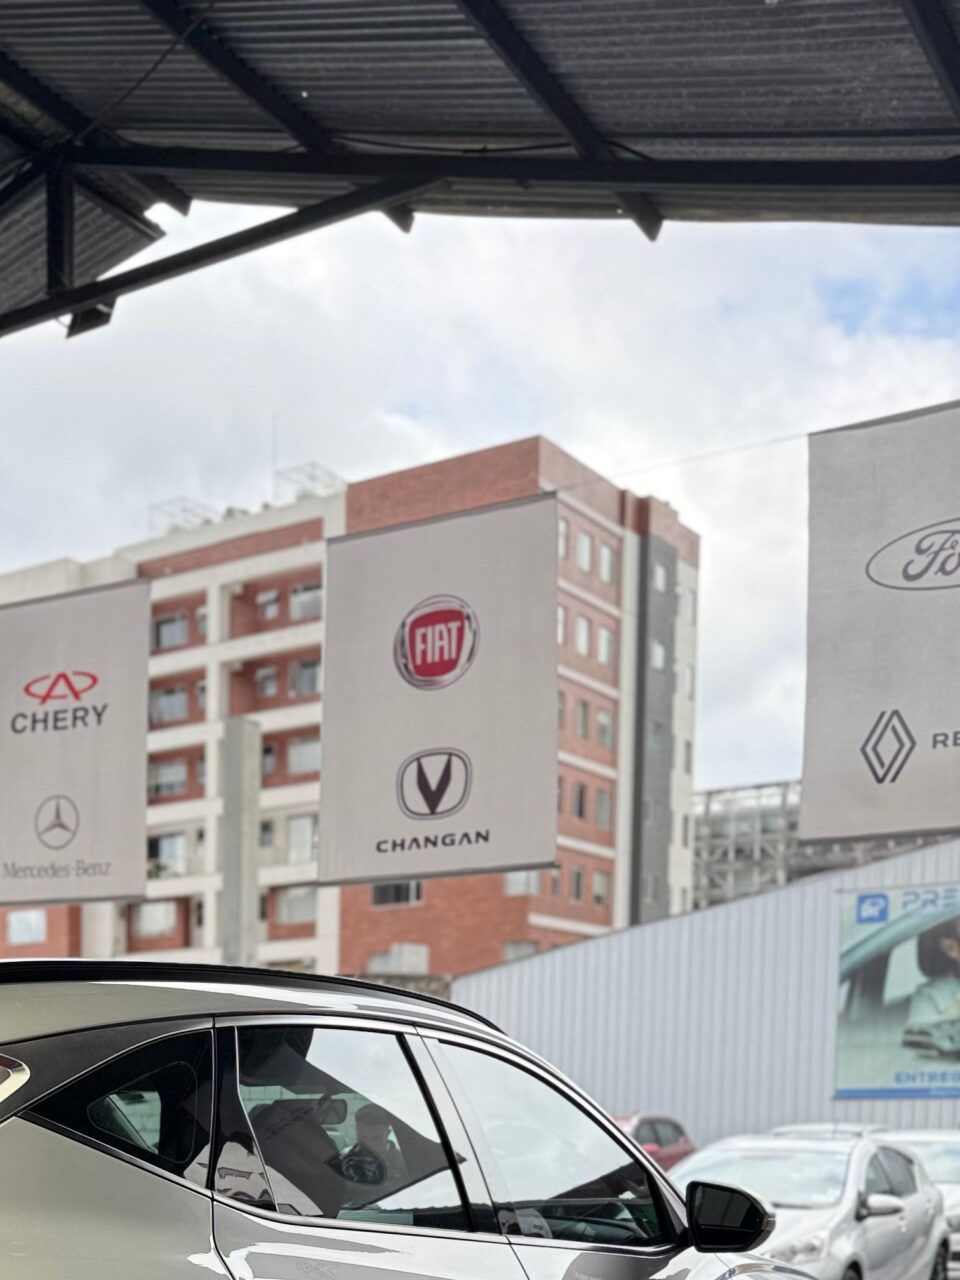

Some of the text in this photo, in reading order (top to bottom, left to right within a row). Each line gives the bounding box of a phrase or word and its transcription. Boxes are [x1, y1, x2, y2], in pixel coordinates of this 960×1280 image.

[415, 621, 461, 666] FIAT
[10, 703, 109, 734] CHERY
[376, 830, 490, 853] CHANGAN
[2, 860, 112, 879] Mercedes-Benz
